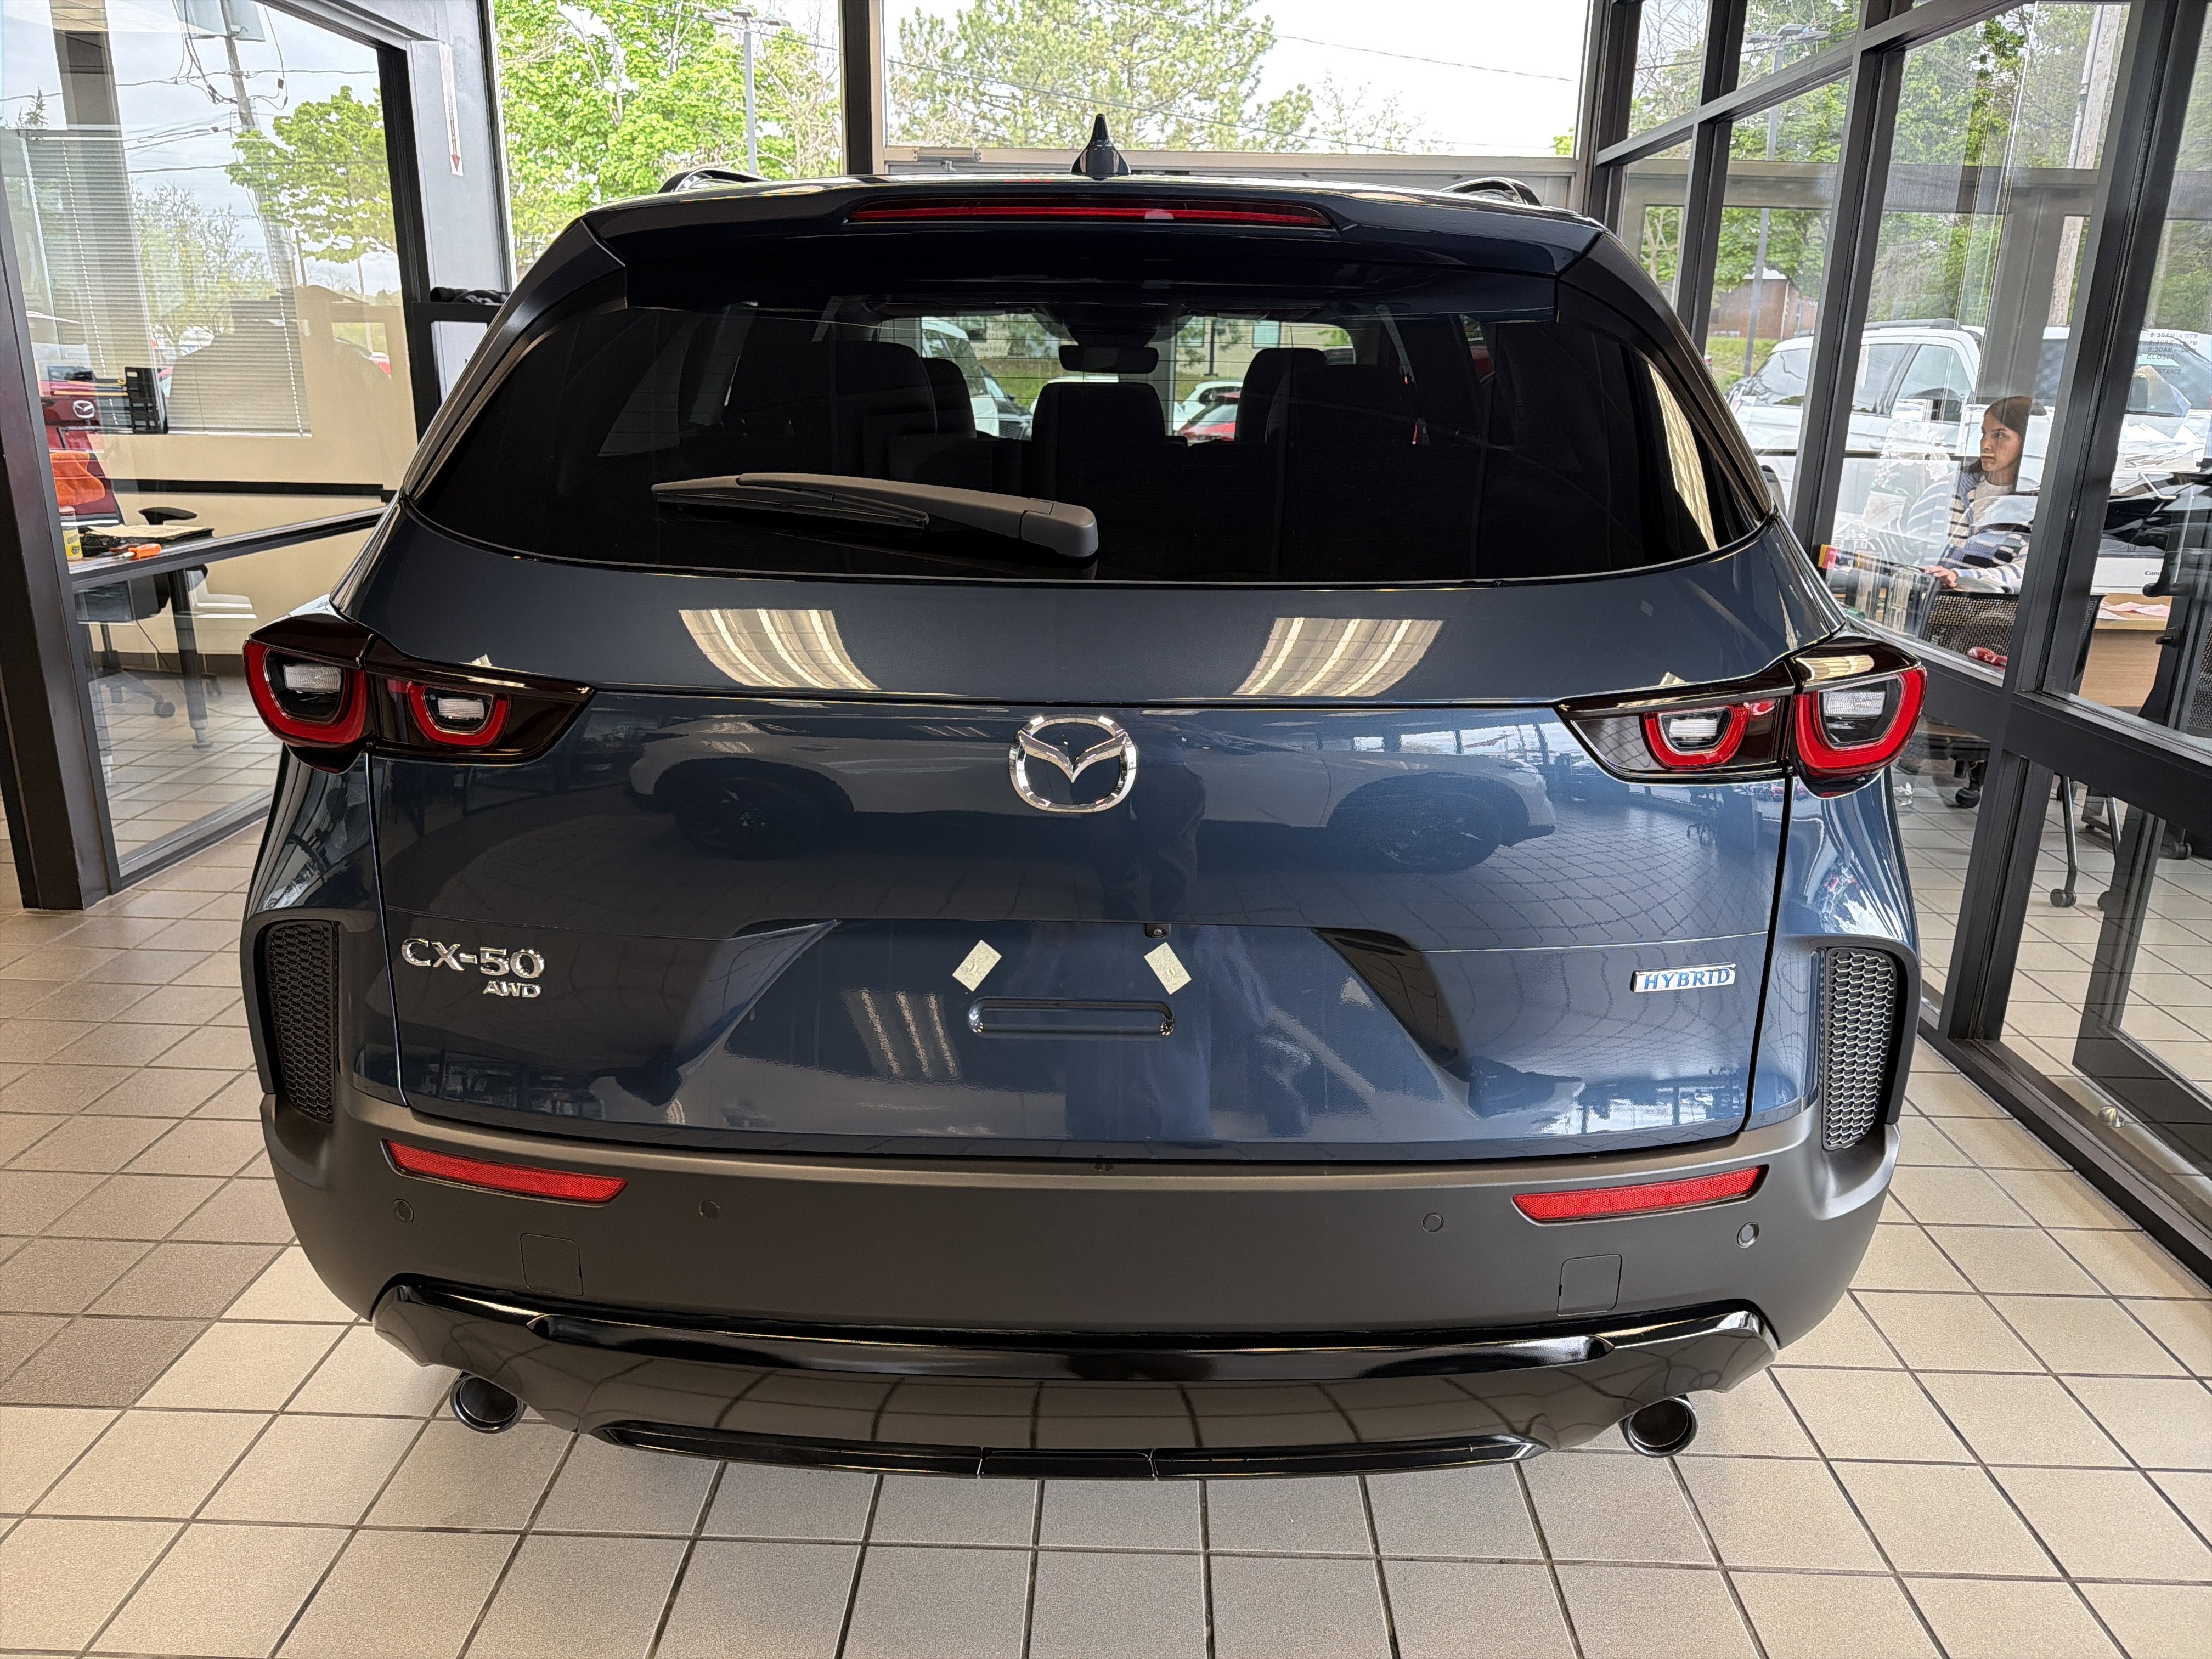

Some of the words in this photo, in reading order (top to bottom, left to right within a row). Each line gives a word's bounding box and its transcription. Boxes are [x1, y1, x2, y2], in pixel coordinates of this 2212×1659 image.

[401, 936, 545, 979] CX-50
[482, 980, 541, 998] AWD
[1644, 968, 1730, 990] HYBRID
